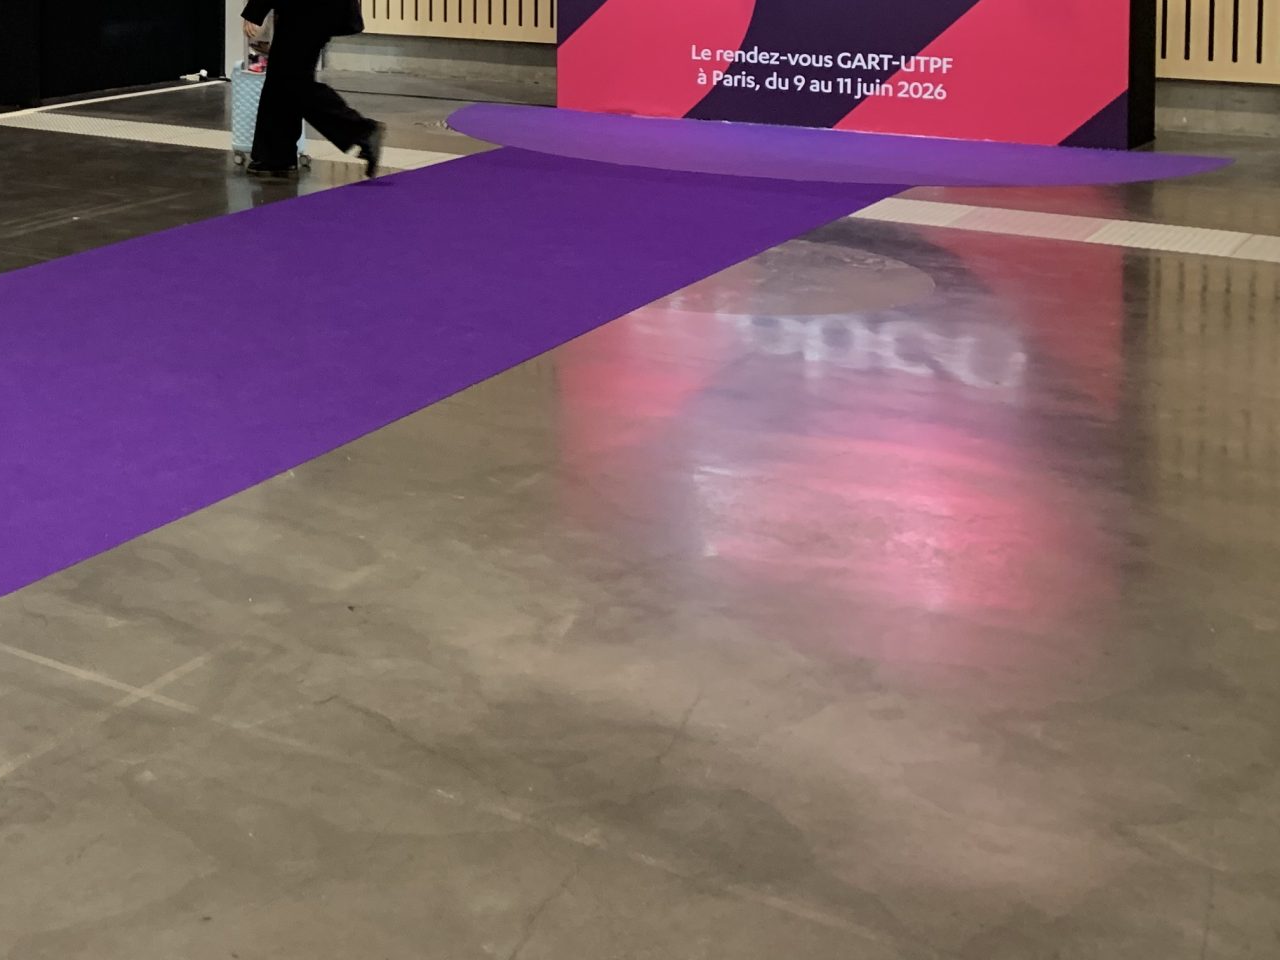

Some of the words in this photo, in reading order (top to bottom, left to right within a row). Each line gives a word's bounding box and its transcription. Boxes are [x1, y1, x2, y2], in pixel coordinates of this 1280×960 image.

[690, 45, 712, 61] Le
[715, 46, 833, 68] rendez-vous
[837, 52, 954, 74] GART-UTPF
[697, 69, 707, 85] à
[712, 71, 761, 91] Paris,
[765, 72, 790, 90] du
[793, 75, 806, 91] 9
[809, 78, 833, 93] au
[836, 78, 852, 94] 11
[854, 78, 894, 100] juin
[897, 82, 948, 101] 2026
